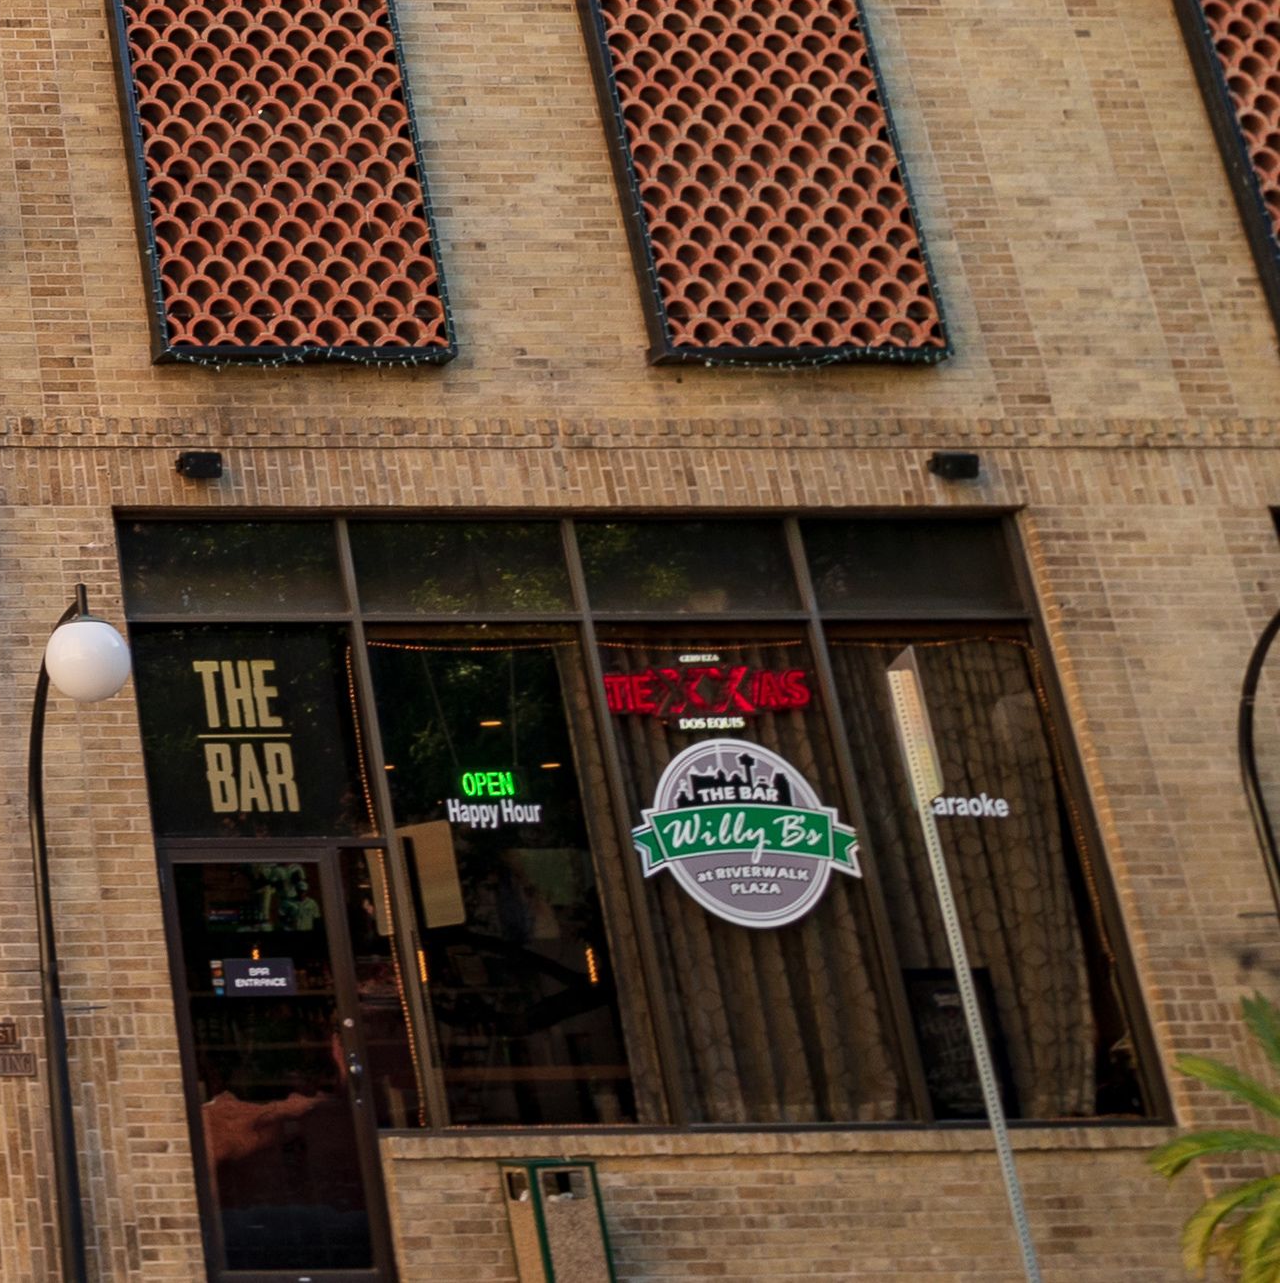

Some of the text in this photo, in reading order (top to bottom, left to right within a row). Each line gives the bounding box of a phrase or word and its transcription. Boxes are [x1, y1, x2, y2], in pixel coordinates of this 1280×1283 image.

[193, 659, 283, 729] THE
[679, 717, 745, 729] DOS EQUIS
[204, 742, 300, 813] BAR
[462, 772, 515, 796] OPEN
[697, 786, 779, 803] THE BAR
[931, 792, 1009, 817] araoke
[447, 798, 541, 828] Happy Hour
[663, 812, 772, 864] Willy
[697, 867, 810, 883] at RIVERWALK
[730, 883, 781, 895] PLAZA
[235, 977, 287, 987] ENTRANCE
[248, 967, 270, 977] BAR
